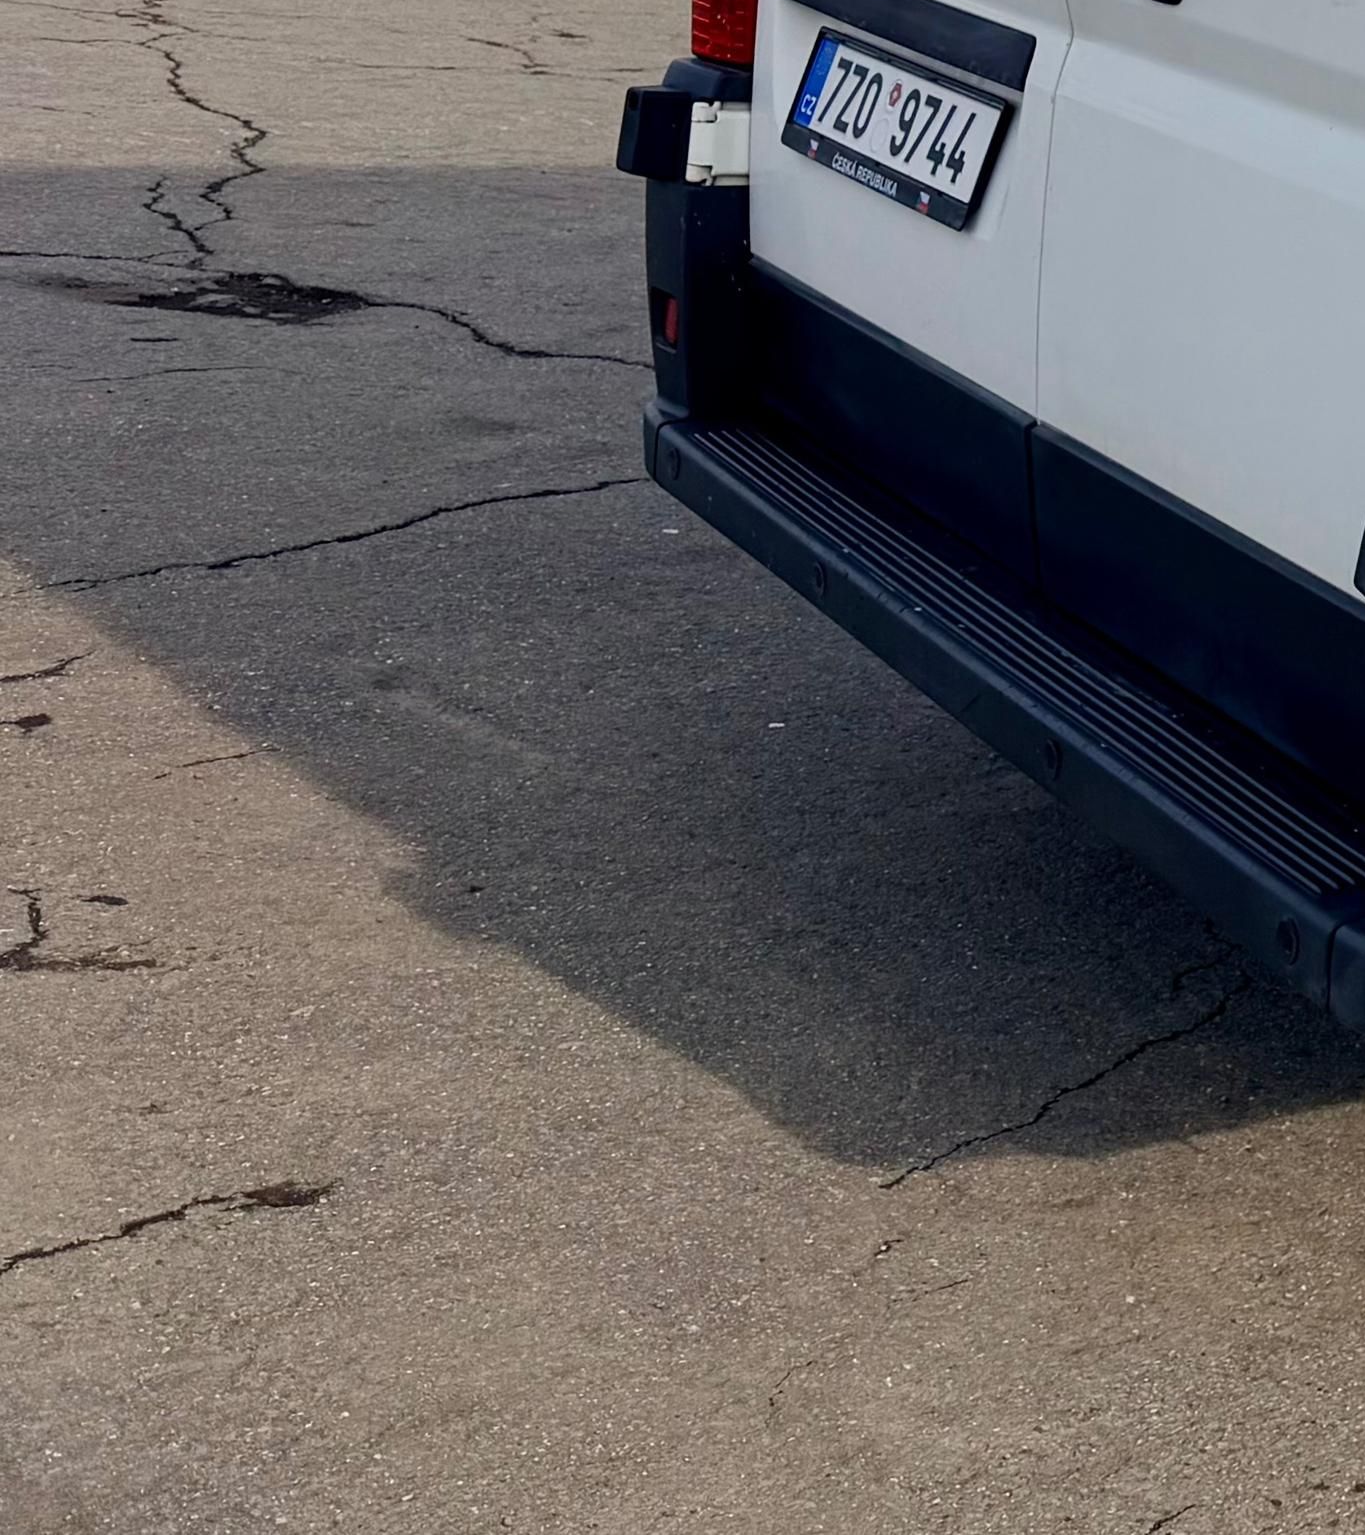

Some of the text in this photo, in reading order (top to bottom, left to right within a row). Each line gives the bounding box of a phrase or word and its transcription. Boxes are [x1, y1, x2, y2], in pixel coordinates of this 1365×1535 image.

[800, 93, 817, 116] CZ
[817, 56, 977, 184] 7Z0 9744
[832, 151, 898, 196] ČESKÁ REPUBLIKA
